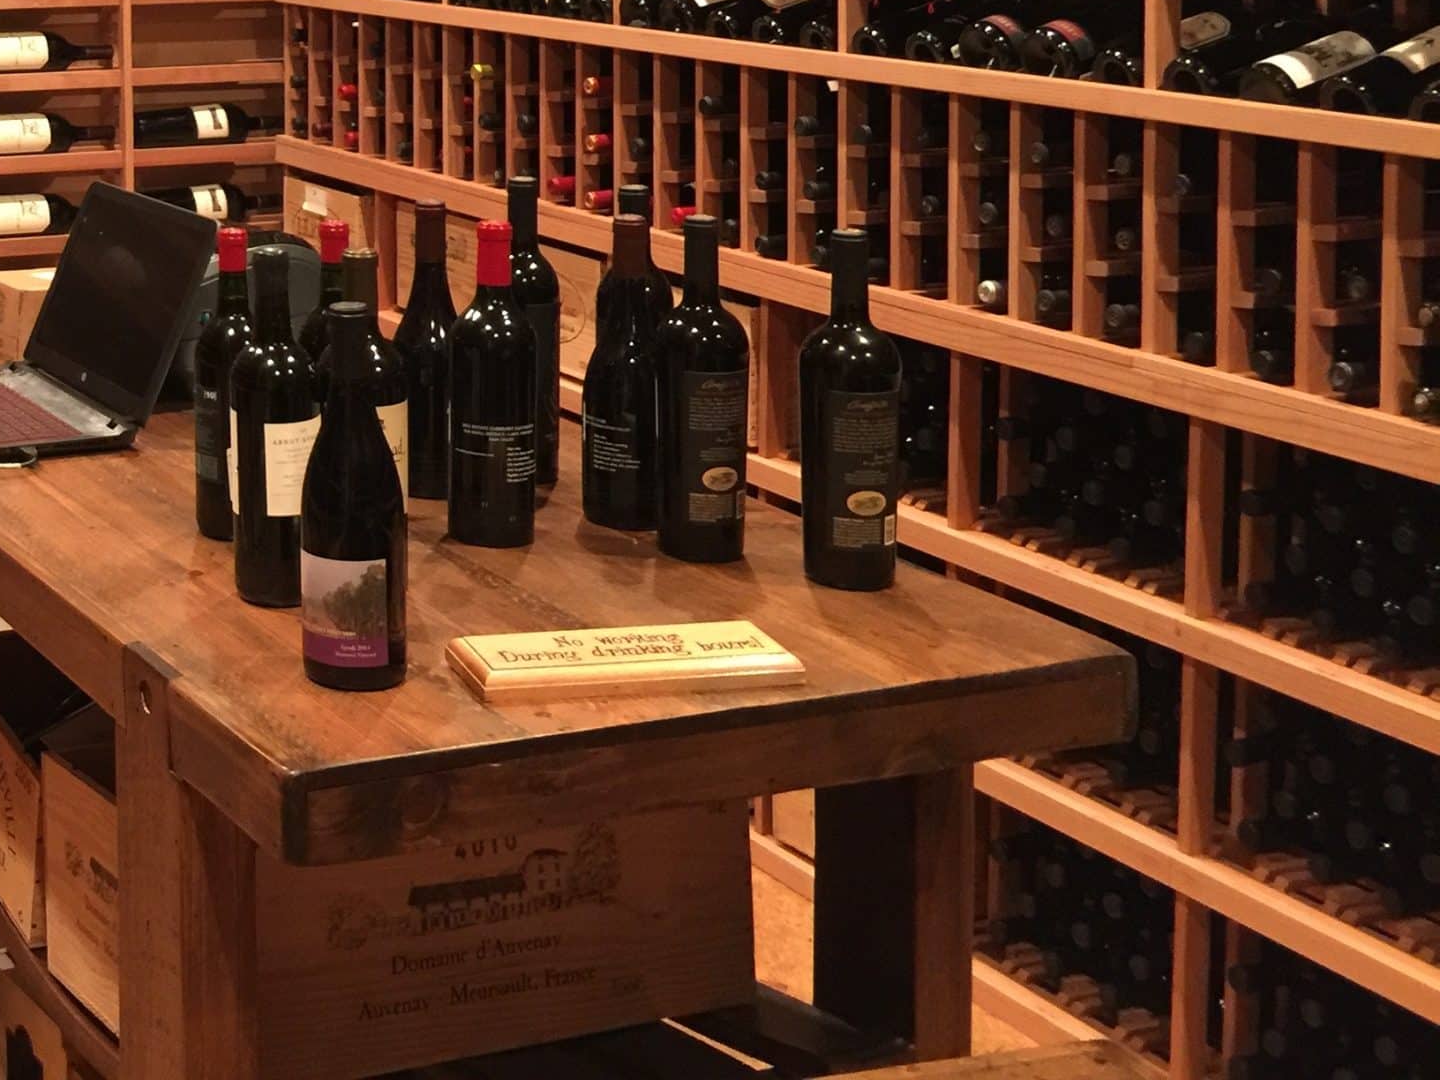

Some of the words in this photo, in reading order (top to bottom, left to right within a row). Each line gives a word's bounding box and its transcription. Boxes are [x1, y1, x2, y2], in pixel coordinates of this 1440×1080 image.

[552, 635, 585, 648] No
[594, 632, 684, 646] working
[497, 647, 583, 663] During
[592, 643, 692, 658] drinking
[390, 952, 467, 977] Domaine
